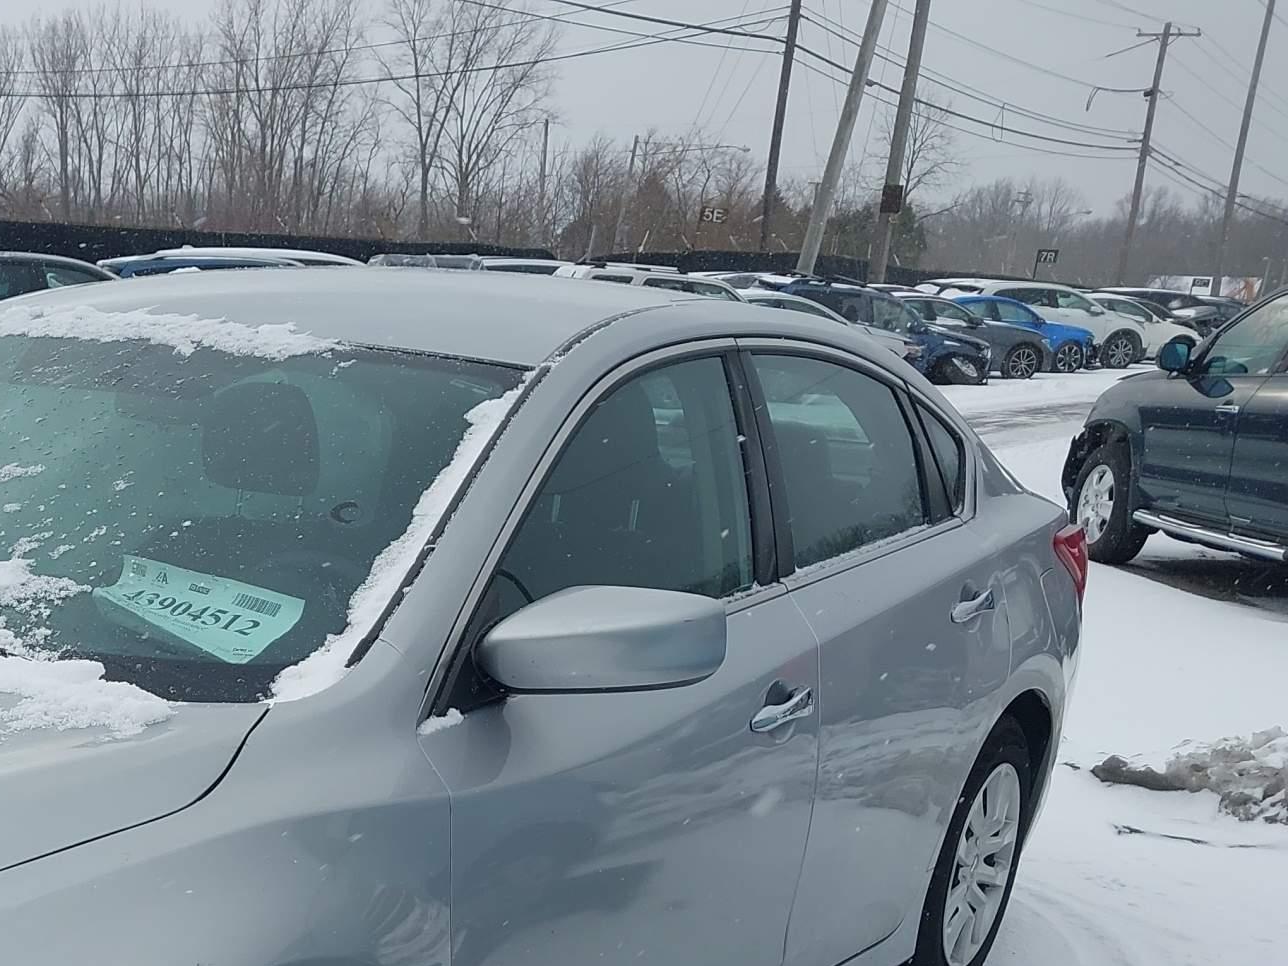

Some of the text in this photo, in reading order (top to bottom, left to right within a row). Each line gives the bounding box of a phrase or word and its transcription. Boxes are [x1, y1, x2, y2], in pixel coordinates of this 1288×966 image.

[703, 207, 724, 223] 5E
[1040, 251, 1056, 262] 7R
[122, 589, 261, 636] 43904512
